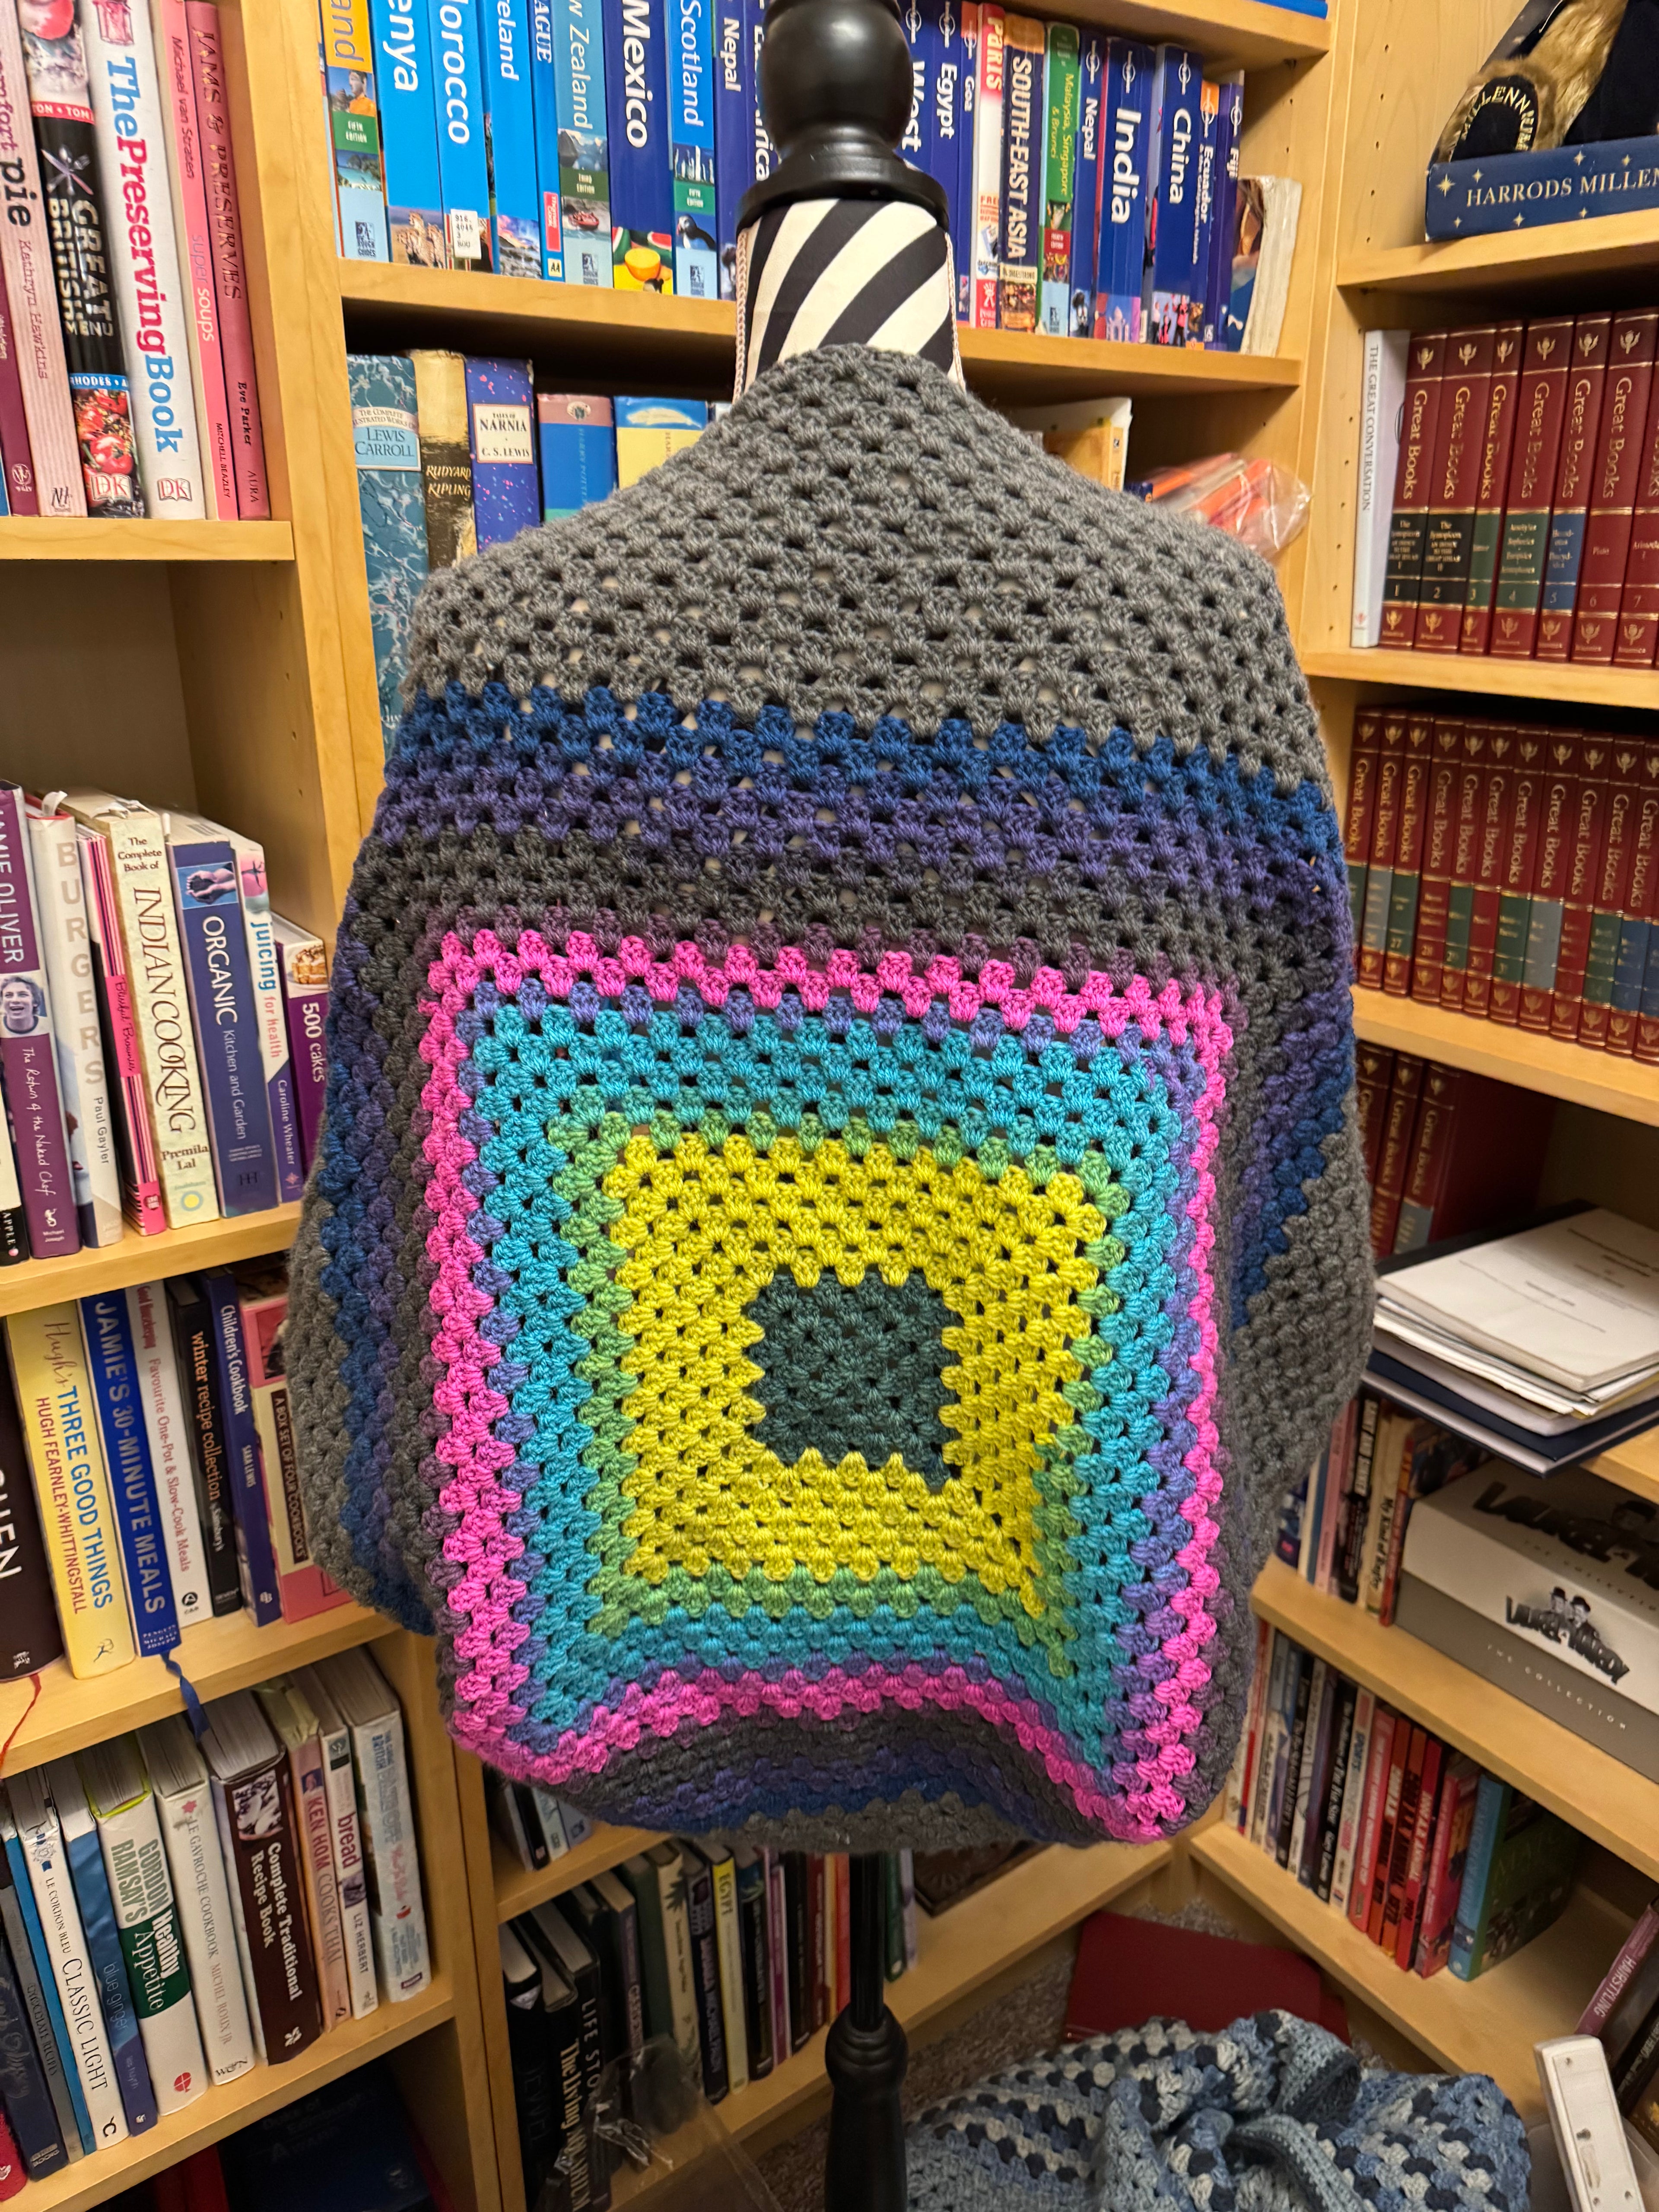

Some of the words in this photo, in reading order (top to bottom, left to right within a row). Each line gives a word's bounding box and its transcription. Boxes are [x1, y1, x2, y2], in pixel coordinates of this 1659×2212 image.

[172, 35, 188, 96] Michael
[497, 0, 519, 81] eland
[680, 0, 704, 127] Scotland
[720, 17, 742, 92] Nepal
[439, 0, 470, 144] orocco
[569, 23, 593, 129] Zealand
[622, 0, 653, 149] Mexico
[964, 76, 975, 112] Goa
[179, 97, 189, 126] van
[937, 62, 957, 139] Egypt
[183, 125, 195, 179] Straten
[1009, 56, 1032, 206] SOUTH-EAST
[1081, 97, 1098, 161] Nepal
[1060, 135, 1073, 196] Singapore
[1111, 107, 1142, 224] India
[1168, 107, 1192, 204] China
[1, 156, 38, 227] pie
[1201, 146, 1214, 224] Ecuador
[1466, 178, 1572, 208] HARRODS
[210, 143, 242, 300] PRESERVES
[1008, 208, 1028, 258] ASIA
[71, 199, 111, 321] GREAT
[191, 235, 210, 285] super
[550, 261, 561, 273] AA
[65, 321, 114, 337] MENU
[197, 287, 215, 342] soups
[1370, 344, 1379, 371] THE
[237, 381, 248, 403] Eve
[372, 409, 404, 419] COMPLETE
[1367, 373, 1378, 415] GREAT
[1410, 388, 1427, 439] Great
[1452, 386, 1471, 439] Great
[1490, 385, 1507, 437] Great
[216, 423, 226, 463] MITCHELL
[241, 407, 251, 446] Parker
[355, 440, 415, 457] CARROLL
[366, 426, 406, 442] LEWIS
[479, 417, 528, 432] NARNIA
[425, 464, 471, 480] RUDYARD
[481, 447, 491, 457] C.
[493, 447, 500, 457] S.
[502, 448, 531, 458] LEWIS
[1361, 417, 1376, 512] CONVERSATION
[1404, 445, 1421, 499] Books
[1444, 443, 1464, 499] Books
[1481, 443, 1500, 499] Books
[159, 479, 191, 499] DK
[220, 464, 231, 498] BEAZLEY
[427, 482, 471, 498] KIPLING
[1433, 586, 1441, 599] 2
[1435, 771, 1452, 816] Great
[1578, 789, 1598, 838] Great
[118, 849, 162, 861] Complete
[124, 863, 149, 872] Book
[150, 861, 160, 870] of
[128, 837, 147, 846] The
[1430, 818, 1447, 868] Books
[1571, 843, 1592, 895] Books
[0, 883, 24, 964] OLIVER
[133, 887, 176, 997] INDIAN
[57, 842, 104, 1085] BURGERS
[203, 916, 238, 1026] ORGANIC
[250, 921, 279, 991] juicing
[263, 995, 276, 1014] for
[302, 1002, 322, 1039] 500
[22, 1046, 35, 1058] The
[150, 1000, 196, 1134] COOKING
[222, 1029, 236, 1072] Kitchen
[309, 1043, 326, 1083] cakes
[25, 1068, 41, 1099] Return
[229, 1074, 243, 1097] and
[30, 1114, 42, 1132] the
[93, 1096, 107, 1125] Paul
[232, 1099, 247, 1141] Garden
[277, 1079, 289, 1122] Caroline
[283, 1123, 296, 1165] Wheater
[35, 1134, 48, 1173] Naked
[96, 1127, 110, 1165] Gayler
[162, 1144, 209, 1161] Premila
[177, 1157, 196, 1170] Lal
[35, 1171, 56, 1197] Chef
[43, 1322, 77, 1387] Hugh's
[95, 1301, 130, 1402] JAMIE'S
[220, 1304, 240, 1361] Children's
[190, 1330, 209, 1388] winter
[196, 1389, 215, 1435] recipe
[227, 1360, 248, 1415] Cookbook
[274, 1397, 284, 1406] A
[35, 1397, 56, 1438] HUGH
[57, 1385, 88, 1461] THREE
[276, 1406, 287, 1425] BOX
[279, 1427, 289, 1447] SET
[112, 1405, 152, 1531] 30-MINUTE
[148, 1357, 165, 1415] Favourite
[157, 1416, 175, 1465] One-Pot
[166, 1476, 185, 1537] Slow-Cook
[176, 1538, 192, 1572] Meals
[201, 1436, 222, 1500] collection
[242, 1445, 253, 1465] SARA
[245, 1465, 257, 1489] LEWIS
[282, 1448, 292, 1461] OF
[285, 1462, 298, 1492] FOUR
[70, 1464, 99, 1526] GOOD
[44, 1442, 87, 1615] FEARNLEY-WHITTINGSTALL
[288, 1492, 309, 1558] COOKBOOKS
[83, 1527, 112, 1609] THINGS
[134, 1534, 165, 1614] MEALS
[1525, 1666, 1626, 1730] COLLECTION
[307, 1796, 324, 1832] KEN
[312, 1833, 331, 1872] HOM
[337, 1812, 361, 1869] bread
[45, 1876, 51, 1889] LE
[111, 1838, 148, 1924] RAMSAY'S
[137, 1838, 171, 1912] GORDON
[189, 1835, 208, 1897] GAVROCHE
[48, 1889, 65, 1931] CORDON
[250, 1850, 268, 1906] Recipe
[259, 1904, 276, 1948] Book
[317, 1873, 337, 1928] COOKS
[718, 1872, 734, 1916] EGYPT
[59, 1931, 72, 1954] BLEU
[151, 1908, 180, 1980] Healthy
[199, 1894, 219, 1959] COOKBOOK
[267, 1842, 288, 1916] Complete
[278, 1914, 303, 2001] Traditional
[353, 1912, 364, 1929] LIZ
[131, 1930, 167, 2012] Appetite
[323, 1928, 344, 1965] THAI
[354, 1929, 369, 1974] HERBERT
[62, 1958, 94, 2035] CLASSIC
[103, 1962, 117, 1992] blue
[210, 1963, 225, 2001] MICHEL
[1592, 1955, 1636, 2017] HAIRSTYLING
[106, 1992, 129, 2031] ginger
[216, 2001, 231, 2032] ROUX
[582, 1996, 599, 2043] LIFE
[80, 2036, 108, 2091] LIGHT
[220, 2032, 233, 2045] JR
